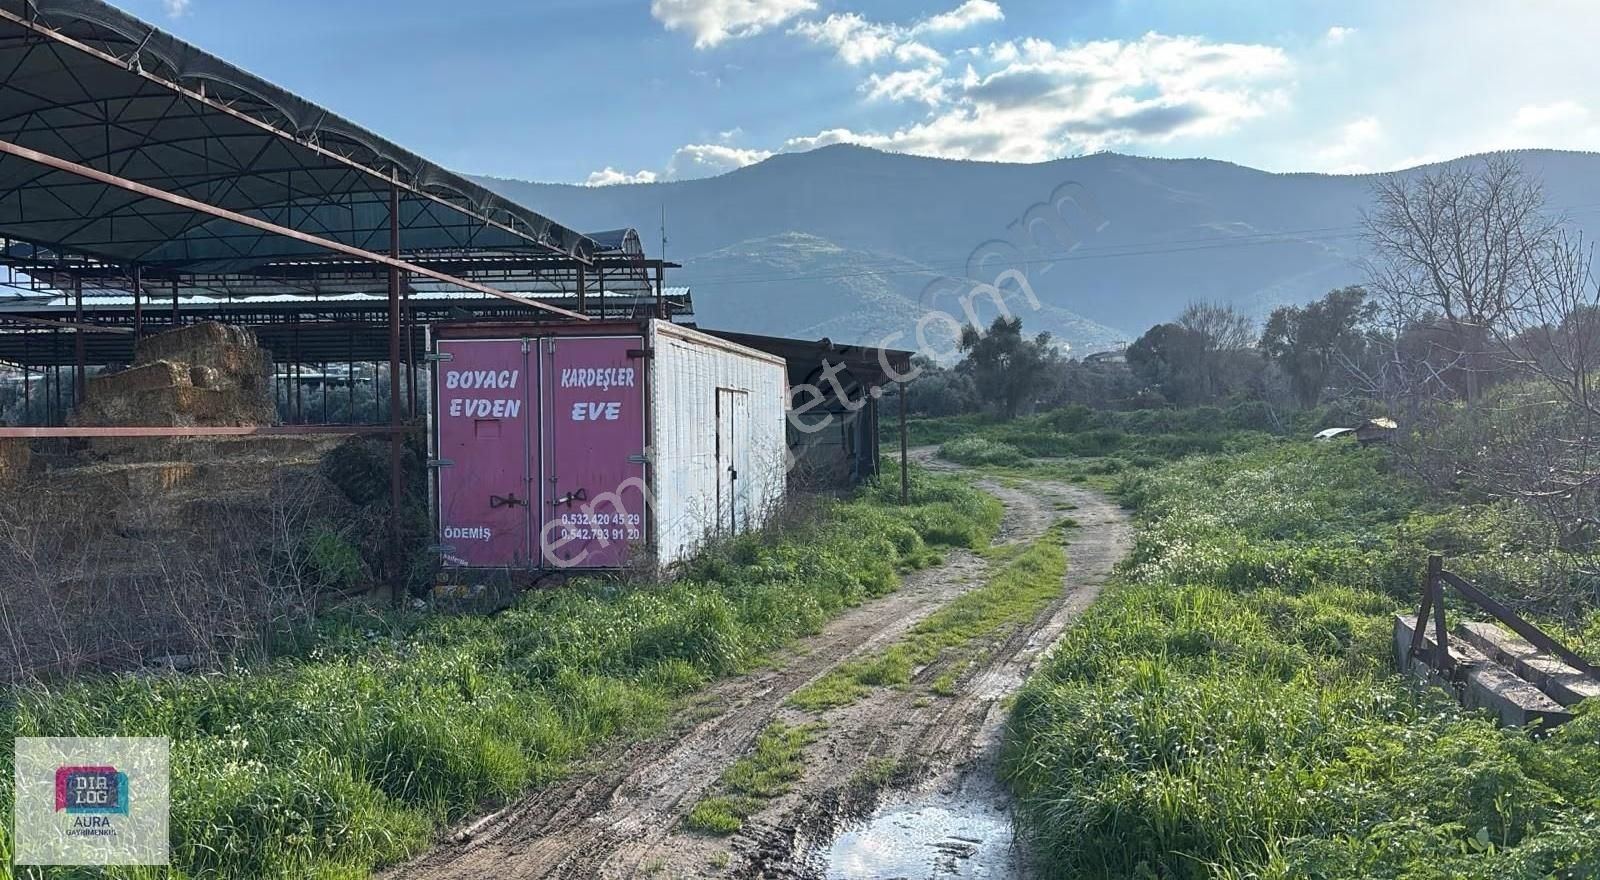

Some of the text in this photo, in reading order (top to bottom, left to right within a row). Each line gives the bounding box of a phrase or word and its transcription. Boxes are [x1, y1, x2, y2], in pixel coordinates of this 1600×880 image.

[446, 367, 634, 391] BOYACI KARDEŞLER
[450, 398, 622, 421] EVDEN EVE
[561, 513, 640, 525] 0.532.420 45 29
[444, 525, 491, 542] ÖDEMİŞ
[561, 528, 640, 540] 0.542.793 91 20
